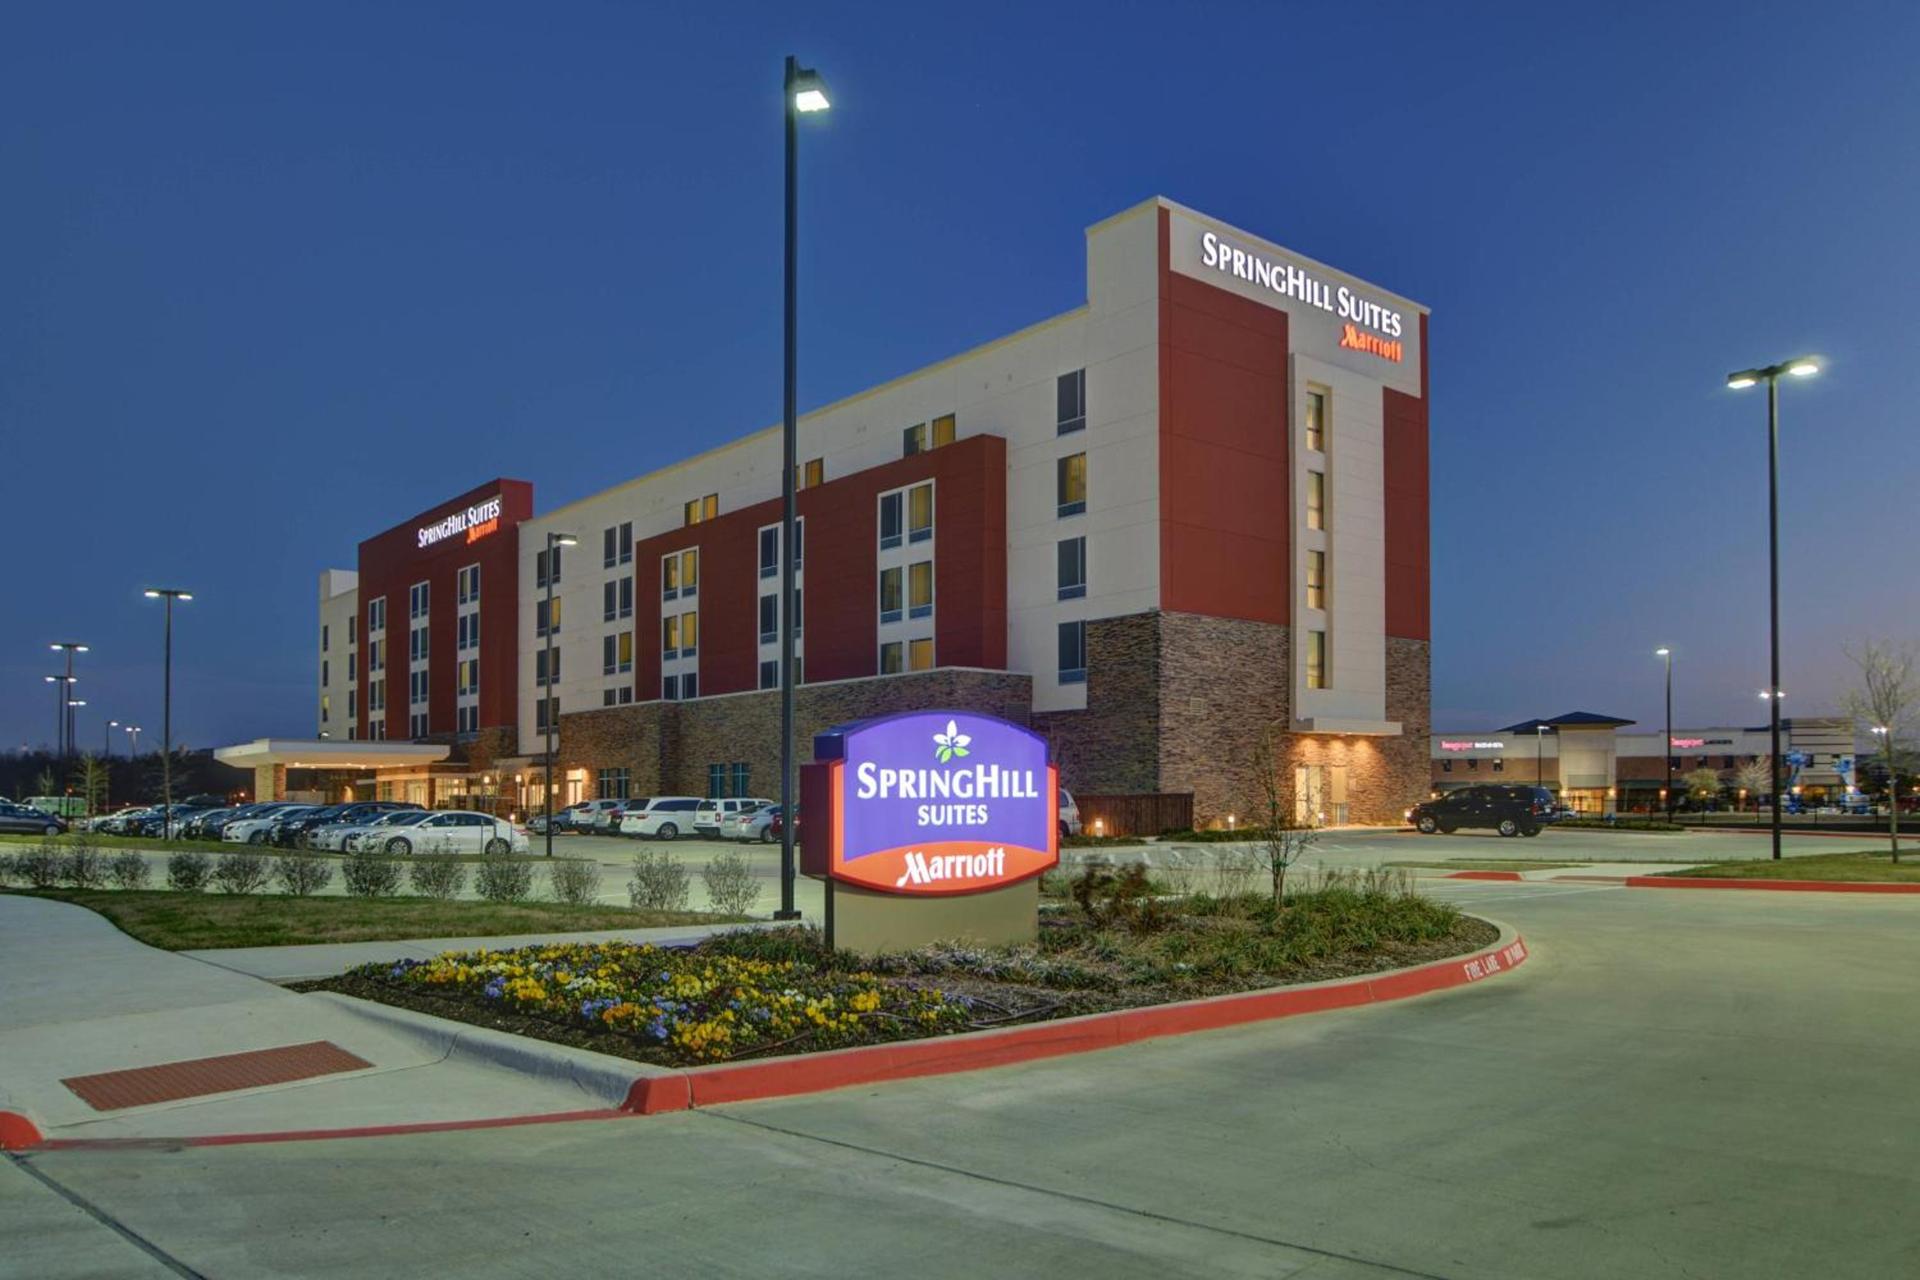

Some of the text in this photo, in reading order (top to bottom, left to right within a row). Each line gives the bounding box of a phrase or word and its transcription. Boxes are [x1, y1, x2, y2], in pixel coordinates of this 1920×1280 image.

[1202, 232, 1401, 337] SPRINGHILL SUITES
[1340, 324, 1402, 362] Marriott
[418, 499, 500, 548] SPRINGHILL SUITES
[857, 762, 1038, 799] SPRINGHILL
[918, 804, 988, 826] SUITES
[896, 847, 1005, 888] Marriott
